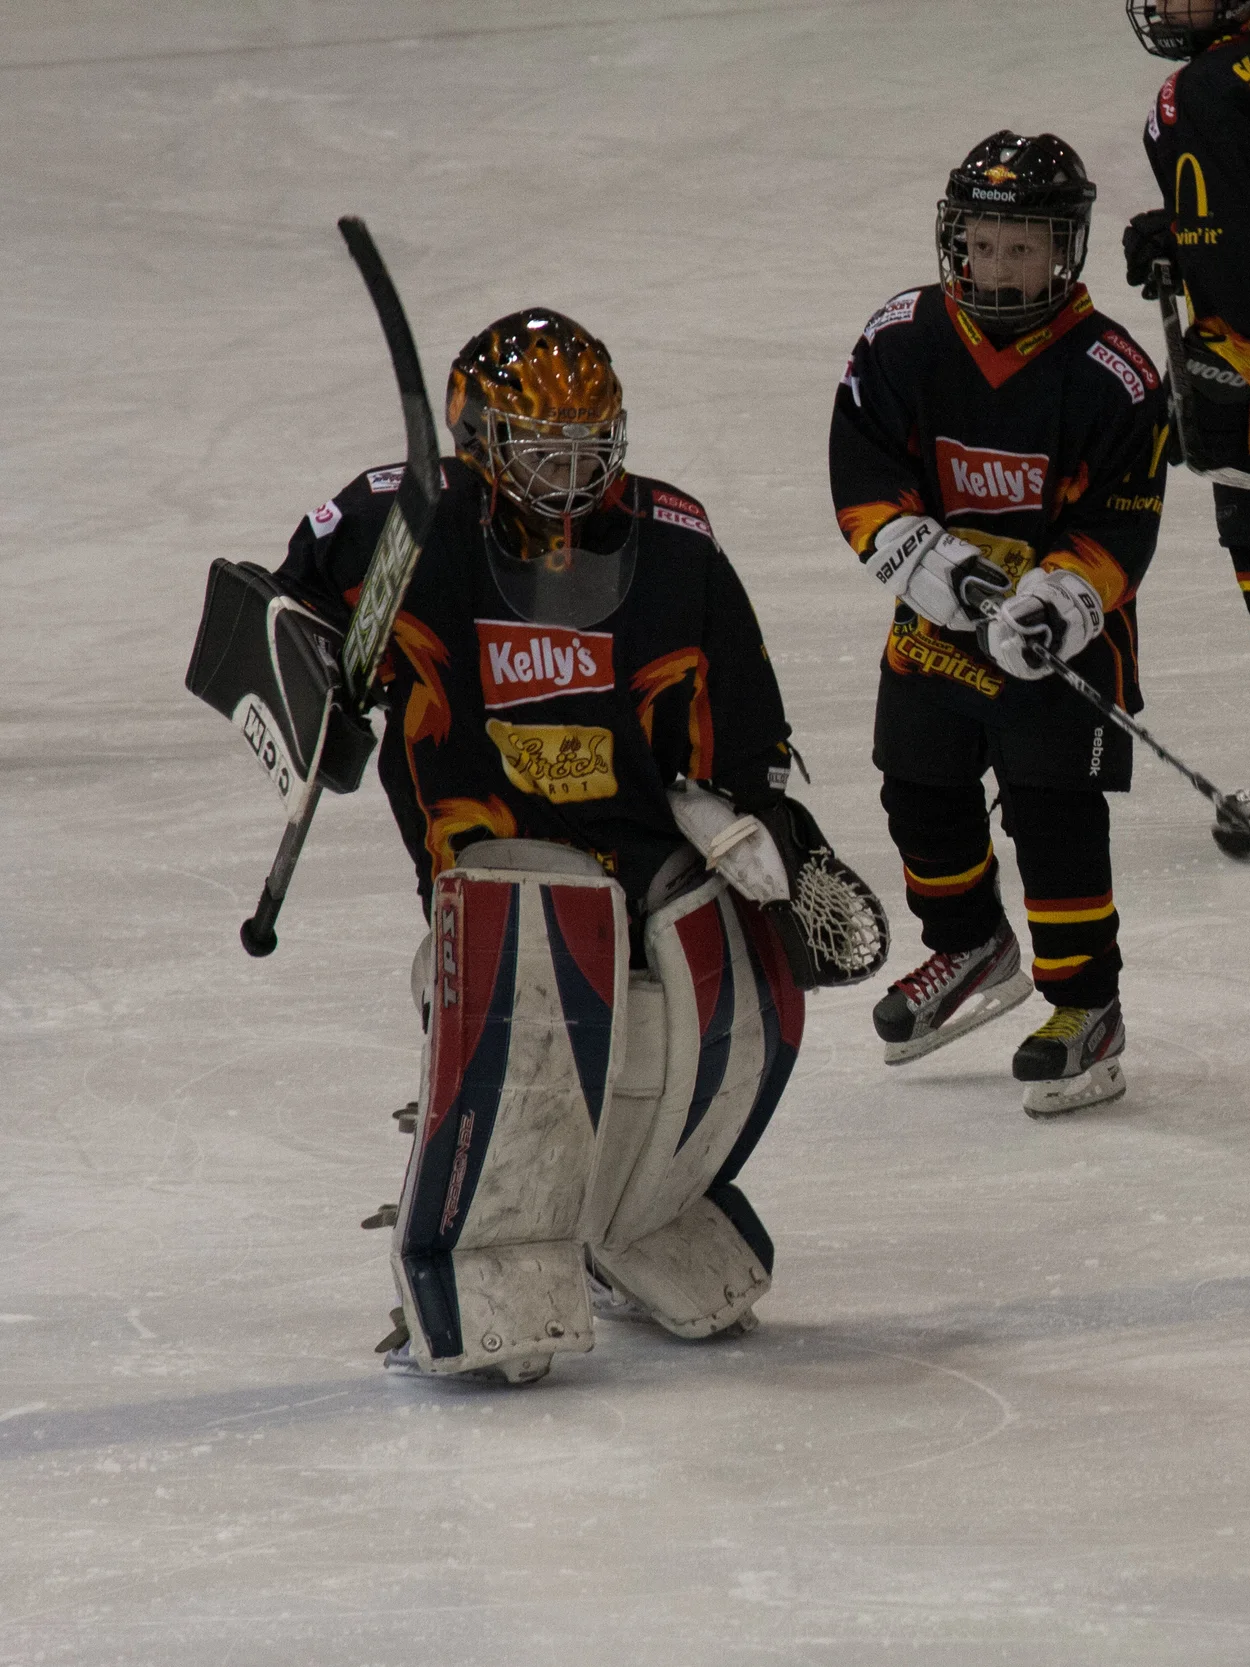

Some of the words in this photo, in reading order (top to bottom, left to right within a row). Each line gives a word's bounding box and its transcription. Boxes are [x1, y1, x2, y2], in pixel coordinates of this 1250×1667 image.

[971, 187, 1017, 202] Reebok
[1092, 345, 1144, 399] RICOH
[1107, 334, 1145, 363] ASKO
[950, 457, 1044, 503] Kelly's
[657, 494, 700, 515] ASKO
[657, 509, 710, 533] RICO
[488, 636, 597, 686] Kelly's
[243, 703, 290, 797] CCM
[1089, 725, 1105, 777] eebok
[442, 905, 459, 1008] TPS
